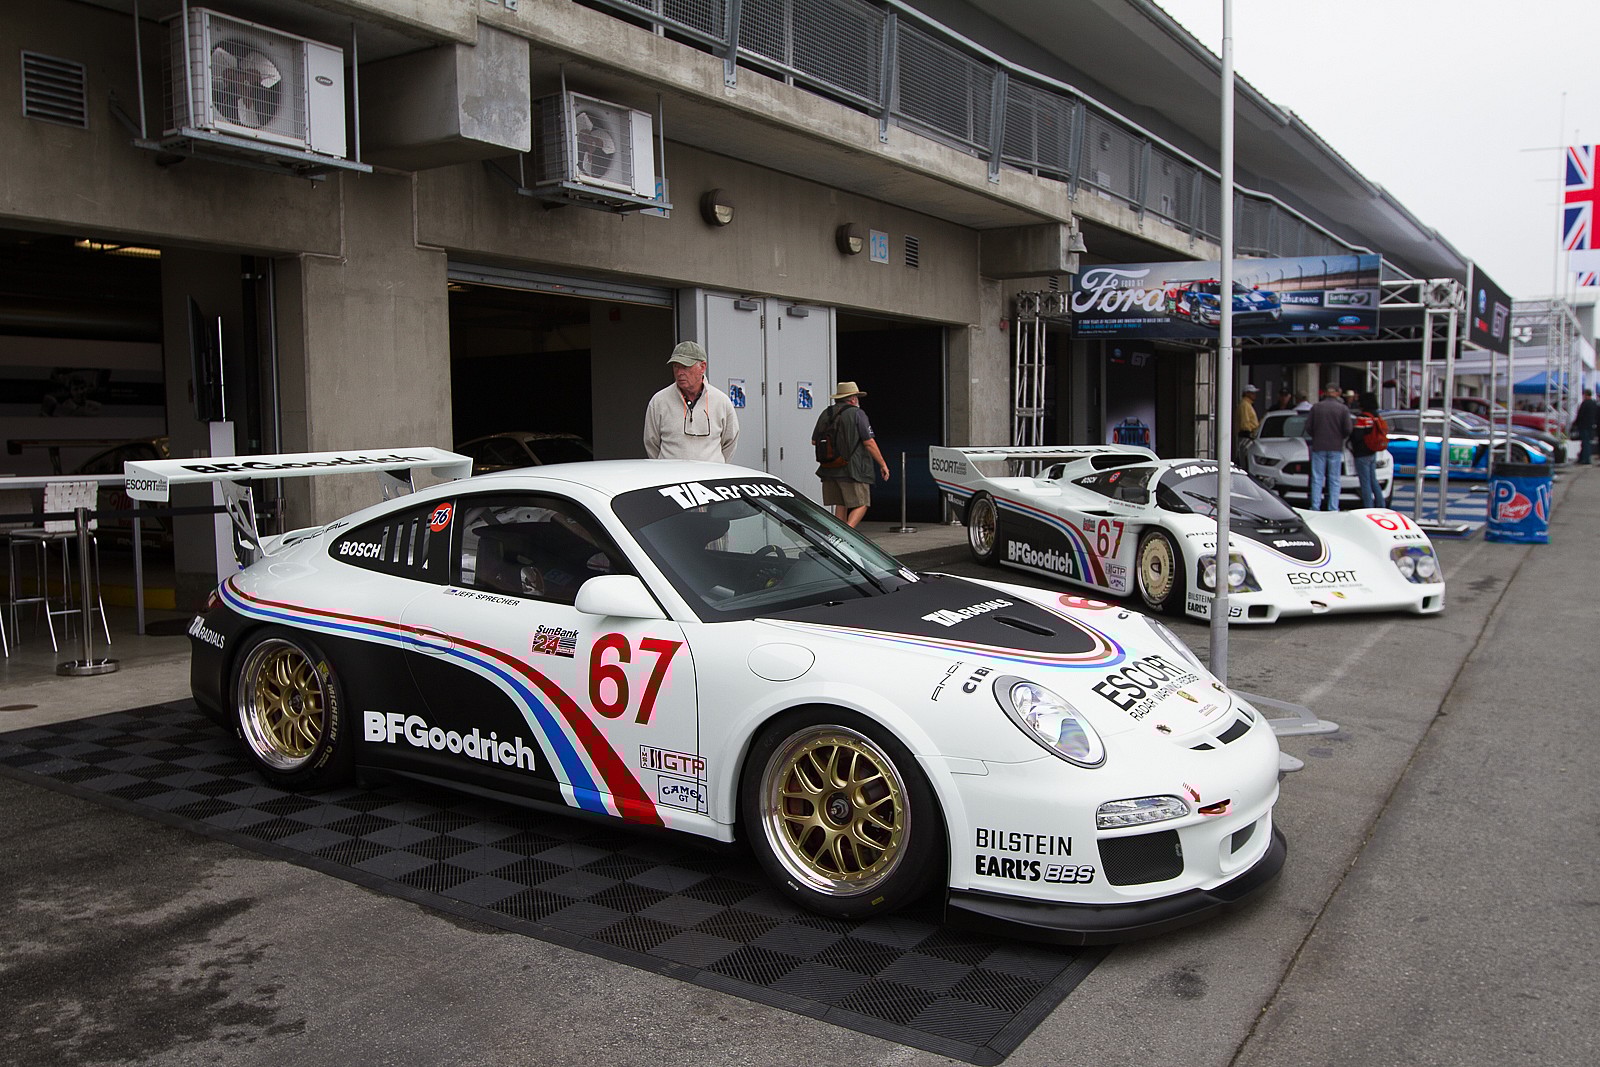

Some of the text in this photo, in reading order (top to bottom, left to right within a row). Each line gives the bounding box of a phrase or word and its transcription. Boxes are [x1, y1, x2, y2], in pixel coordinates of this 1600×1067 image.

[872, 234, 887, 259] 15
[1072, 268, 1173, 313] Ford
[1453, 447, 1470, 460] 14
[932, 458, 958, 473] ESCORT
[126, 479, 157, 491] ESCORT
[431, 508, 451, 525] 76
[1366, 512, 1411, 531] 67
[1097, 519, 1125, 559] 67
[340, 541, 382, 558] BOSCH
[1008, 540, 1073, 575] BFGoodrich
[1112, 566, 1126, 575] GTP
[1287, 571, 1358, 585] ESCORT
[476, 594, 520, 606] SPRECHER
[1188, 592, 1212, 603] BILSTEIN
[960, 599, 1014, 620] RADIALS
[1187, 602, 1207, 614] EARL'S
[199, 626, 226, 649] RADIALS
[536, 624, 580, 639] SunBank
[532, 634, 560, 654] 24
[589, 632, 684, 725] 67
[1092, 655, 1187, 712] ESCORT
[327, 683, 339, 742] MICHELIN
[363, 710, 536, 772] BFGoodrich
[664, 753, 705, 775] GTP
[662, 785, 705, 804] CAMEL
[679, 794, 689, 803] GT
[976, 828, 1072, 857] BILSTEIN
[975, 854, 1096, 885] EARL'S BBS
